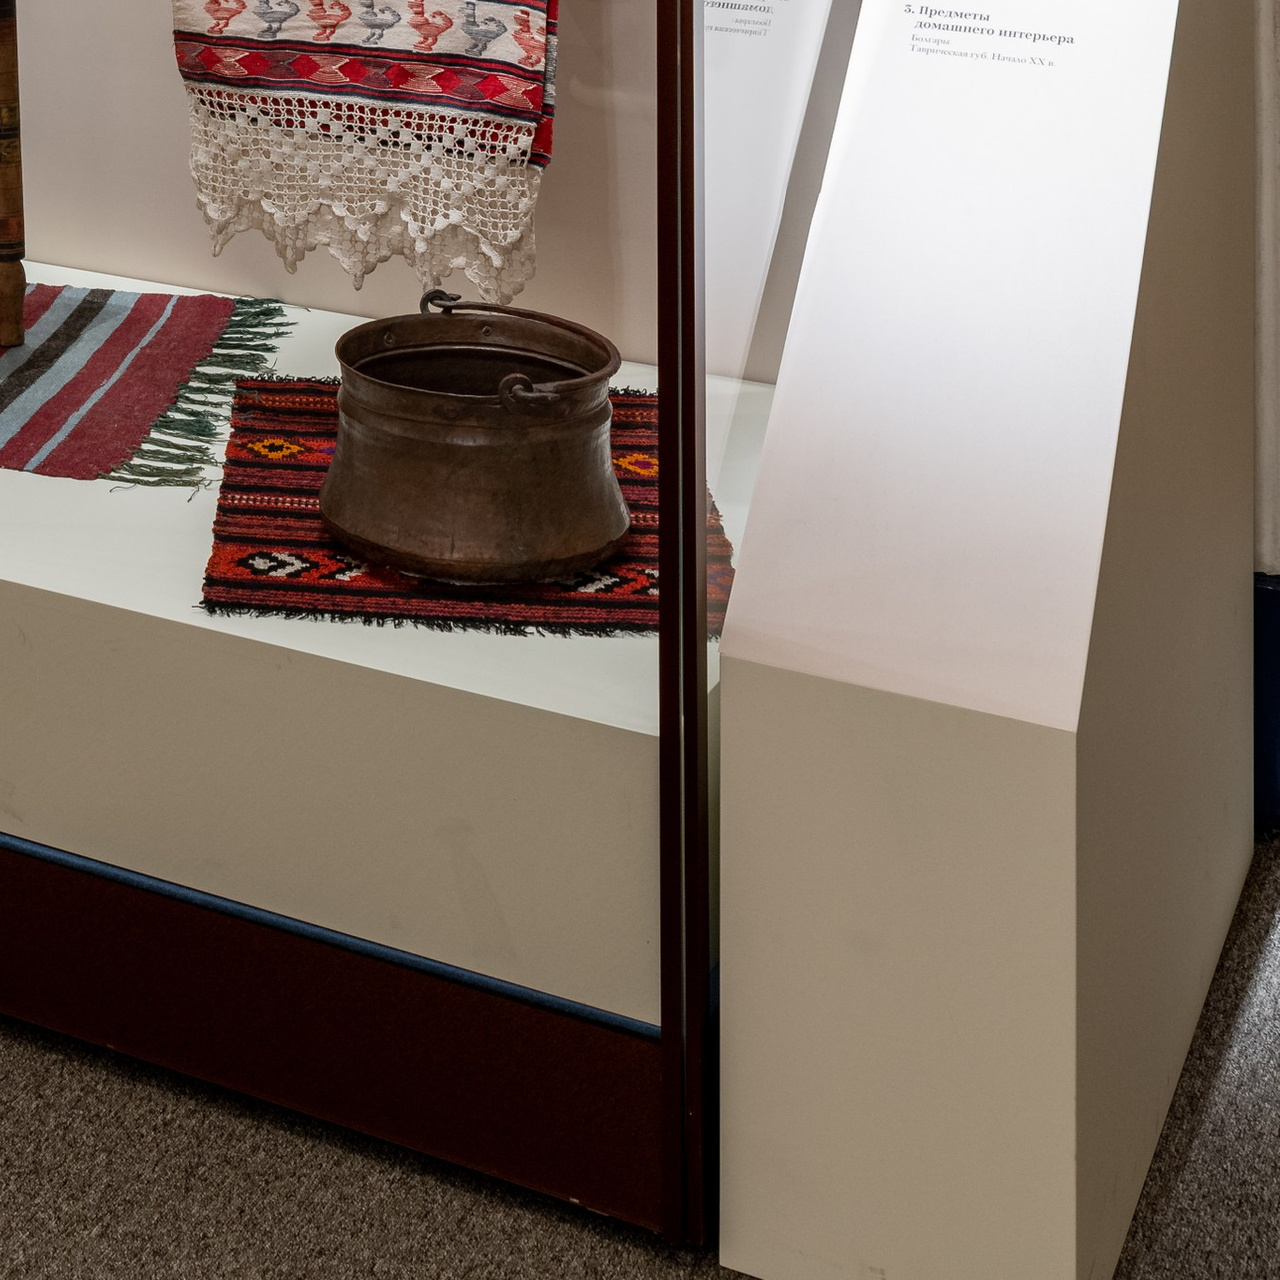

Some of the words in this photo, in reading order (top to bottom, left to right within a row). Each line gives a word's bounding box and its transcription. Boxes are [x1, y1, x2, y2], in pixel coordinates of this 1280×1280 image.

[903, 3, 915, 14] 3.
[919, 4, 990, 21] Предметы
[914, 21, 995, 35] домашнего
[998, 29, 1074, 45] интерьера
